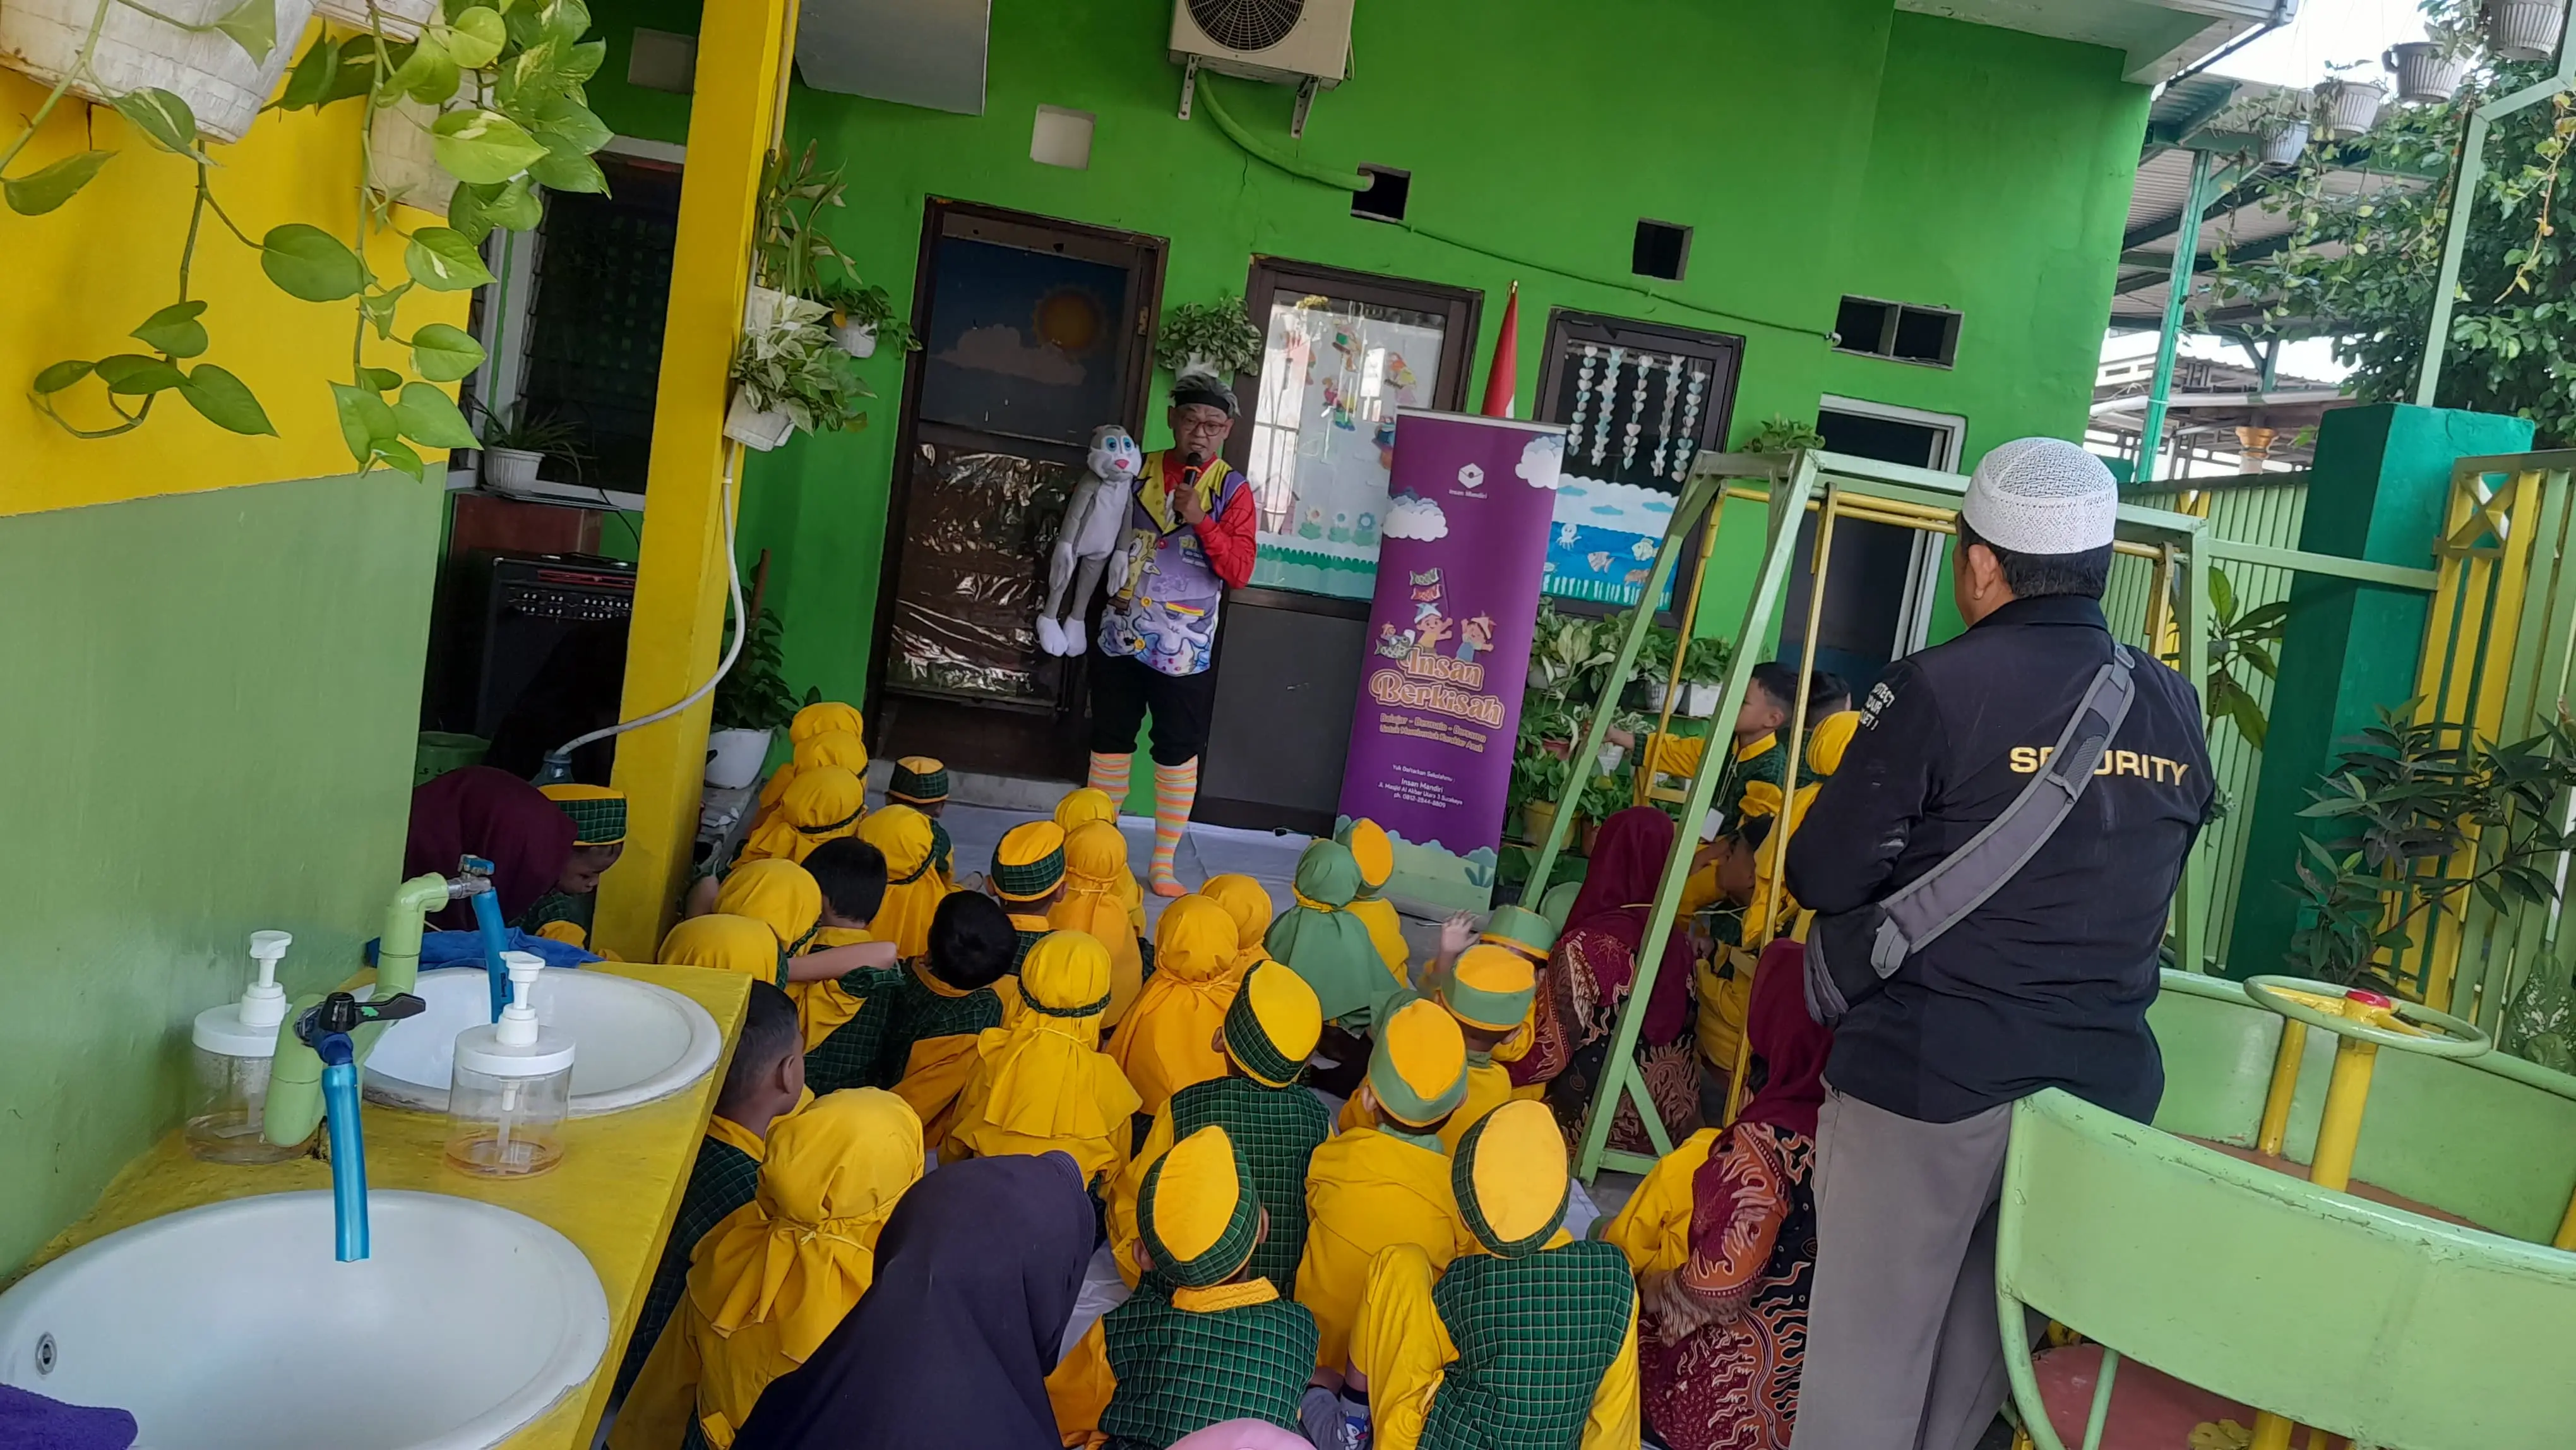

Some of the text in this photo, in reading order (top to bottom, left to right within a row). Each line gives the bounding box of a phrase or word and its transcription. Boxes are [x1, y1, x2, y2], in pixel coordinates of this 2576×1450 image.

[1397, 645, 1483, 690] Insan
[1369, 669, 1505, 728] Berkisah
[1866, 695, 1883, 715] OUR
[1402, 778, 1443, 793] Insan Mandiri
[2010, 746, 2189, 786] SURITY
